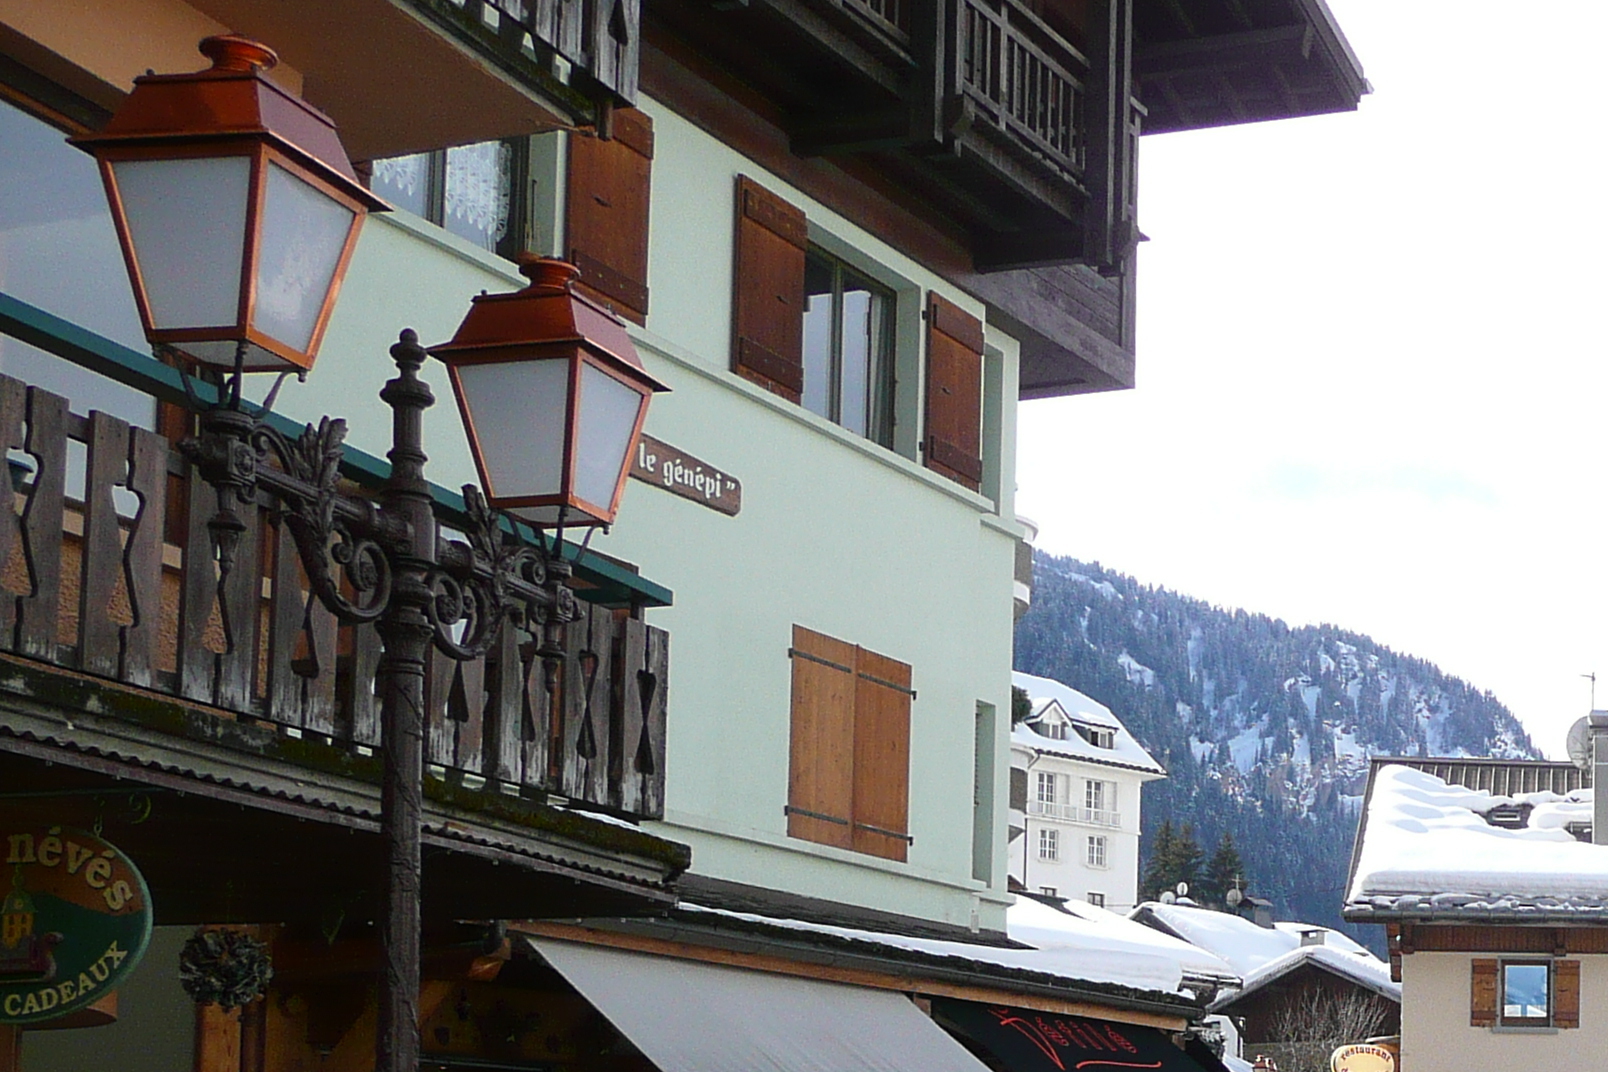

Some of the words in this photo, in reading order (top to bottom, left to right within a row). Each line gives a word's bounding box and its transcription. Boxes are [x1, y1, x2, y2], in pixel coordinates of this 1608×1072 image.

[639, 443, 656, 472] le
[6, 826, 133, 911] névés
[4, 940, 128, 1016] CADEAUX
[1341, 1046, 1391, 1063] restaurant
